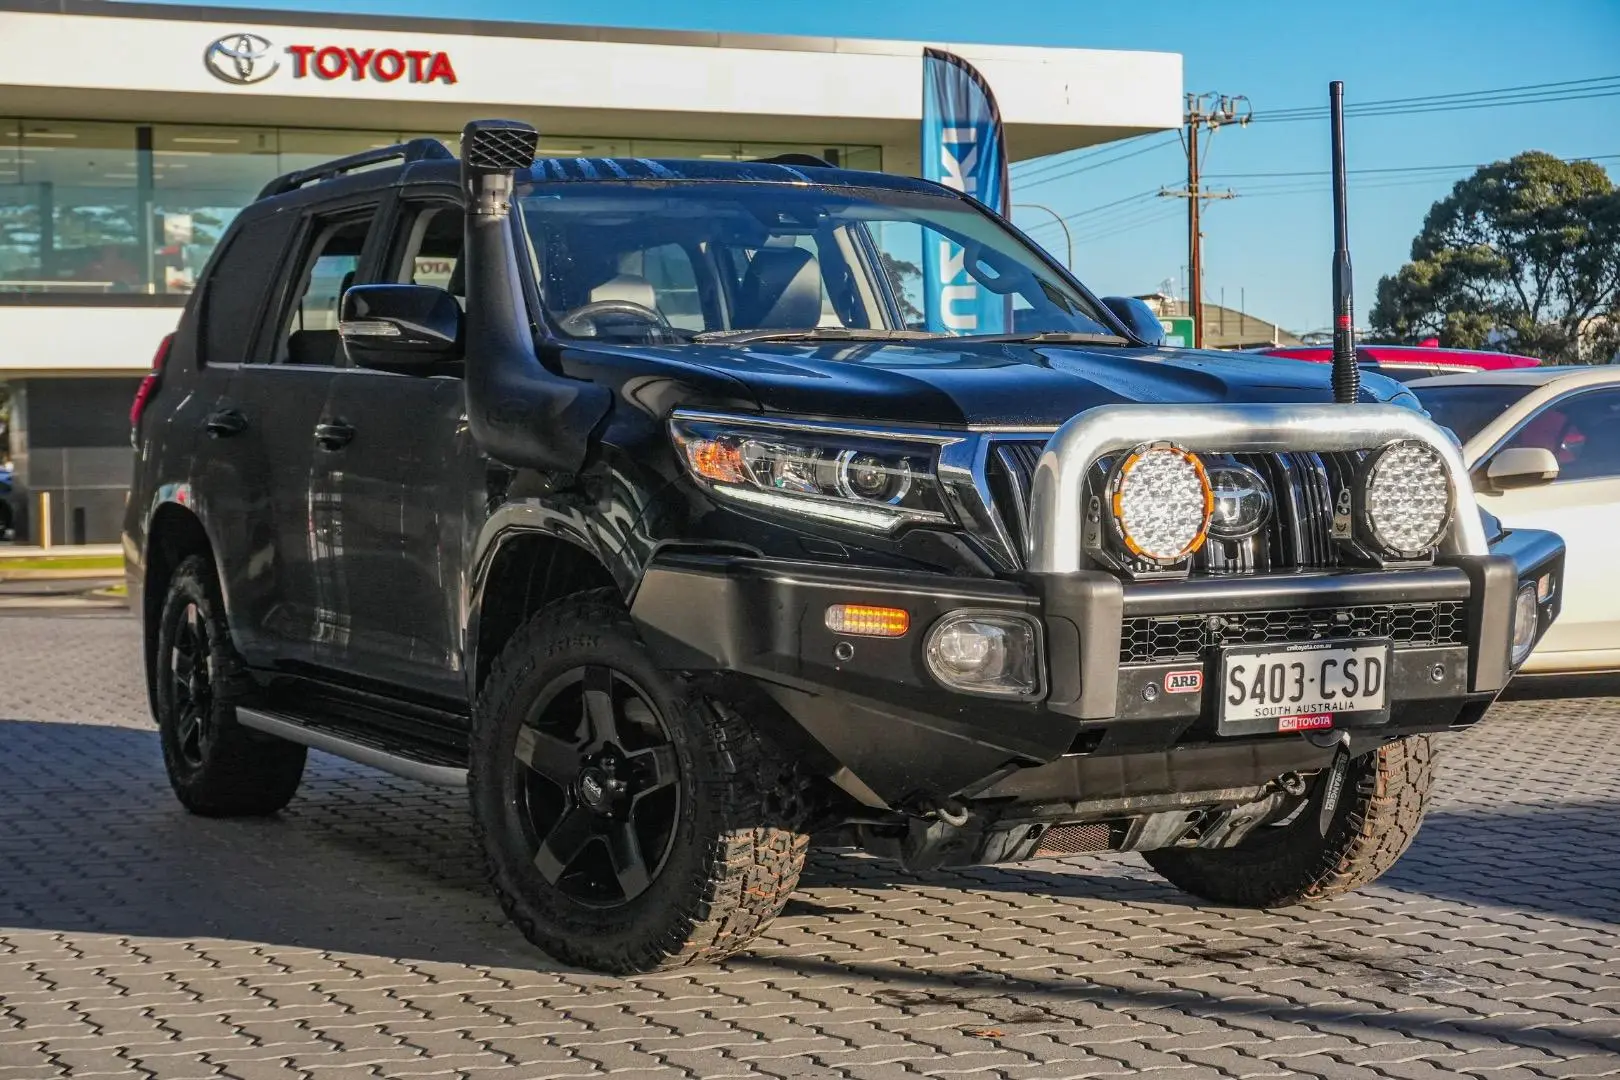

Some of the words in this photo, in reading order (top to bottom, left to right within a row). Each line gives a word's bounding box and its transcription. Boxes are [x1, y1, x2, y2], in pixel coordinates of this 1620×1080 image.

[287, 45, 458, 85] TOYOTA
[1170, 675, 1198, 688] ARB
[1255, 705, 1291, 717] SOUTH
[1296, 701, 1355, 715] AUSTRALIA
[1281, 718, 1296, 728] CMI
[1299, 716, 1330, 727] TOYOTA
